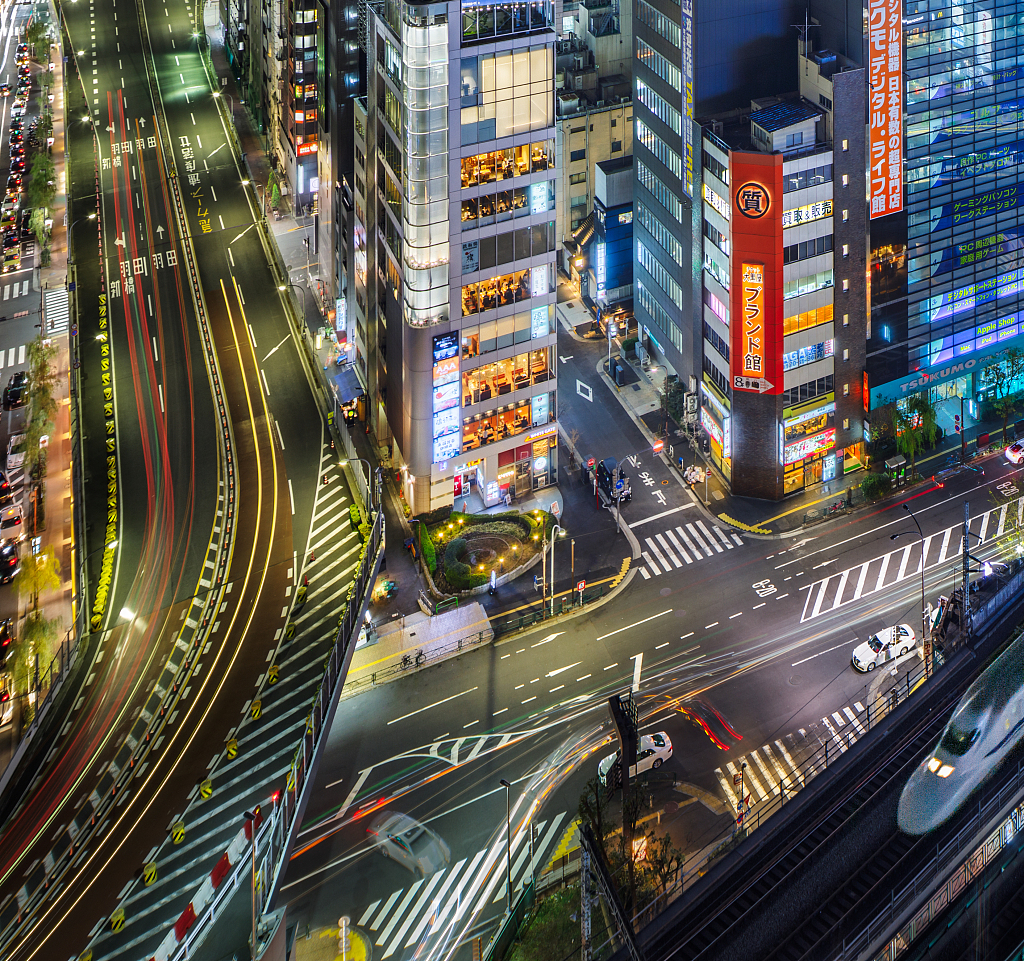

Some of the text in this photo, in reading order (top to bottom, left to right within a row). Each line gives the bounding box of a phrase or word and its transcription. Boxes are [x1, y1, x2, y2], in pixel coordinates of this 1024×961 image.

[135, 136, 157, 150] 羽田
[888, 76, 900, 209] 日本有数の超専門店
[954, 187, 1017, 212] ゲーミングパソコン
[783, 200, 832, 227] 買取&販売
[954, 198, 1017, 223] ワークステーション
[960, 233, 1004, 253] PC周辺機器
[152, 249, 178, 269] 羽田
[960, 245, 1004, 265] 家庭用ゲーム
[120, 257, 144, 277] 羽田
[110, 276, 135, 299] 新橋
[744, 286, 762, 372] ブランド館
[977, 316, 1015, 335] Apple Shop
[1000, 328, 1016, 338] iPhone
[960, 344, 971, 352] Mac
[981, 336, 992, 344] iPad
[436, 363, 457, 374] AAA
[900, 359, 977, 392] TSUKUMO
[545, 426, 556, 436] GATE
[626, 453, 667, 506] 止まれ
[752, 579, 778, 597] 8-20
